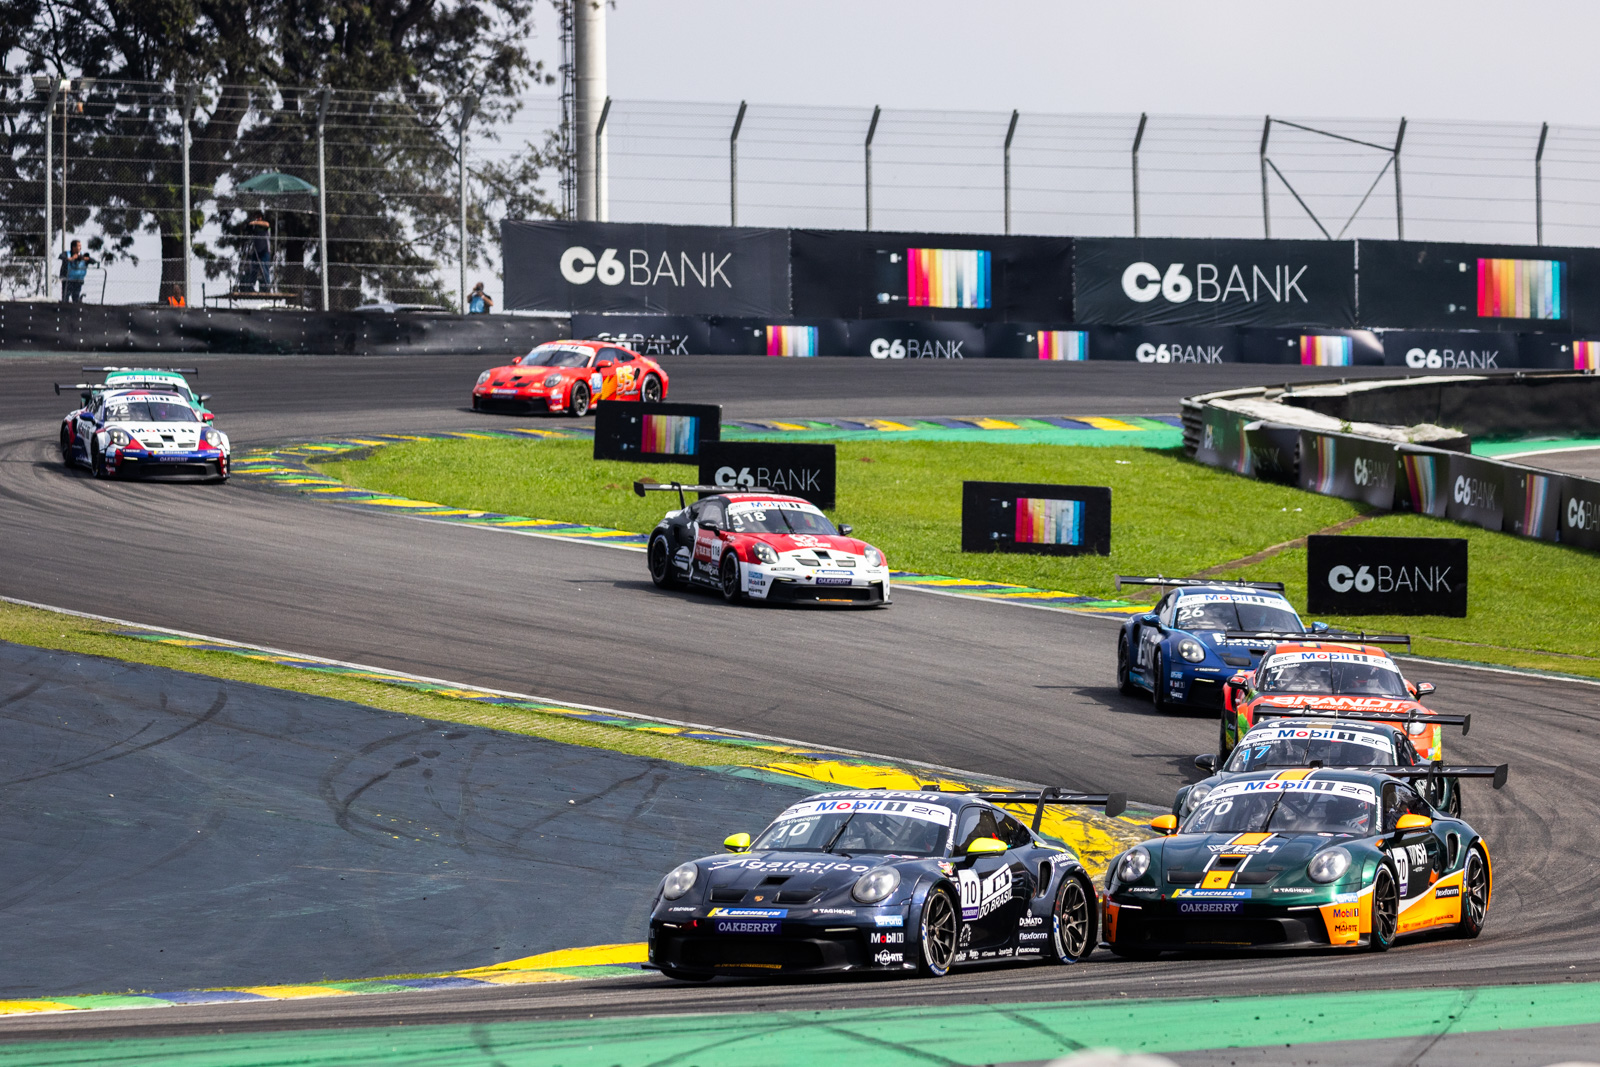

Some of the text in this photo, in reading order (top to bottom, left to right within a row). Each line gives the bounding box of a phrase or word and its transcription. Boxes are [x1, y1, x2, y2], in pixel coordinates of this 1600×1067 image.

[1179, 607, 1205, 620] 26
[1301, 652, 1350, 661] Mobil
[1271, 696, 1401, 709] BRANDT
[1277, 730, 1335, 739] Mobil
[1244, 781, 1310, 791] Mobil
[815, 801, 883, 812] Mobil
[1200, 801, 1233, 821] 70
[776, 822, 811, 840] 10
[964, 880, 977, 905] 10
[729, 909, 782, 917] MICHELIN
[1181, 904, 1239, 912] OAKBERRY
[1333, 908, 1353, 918] Mobil
[718, 922, 778, 933] OAKBERRY
[870, 932, 896, 944] Mobil
